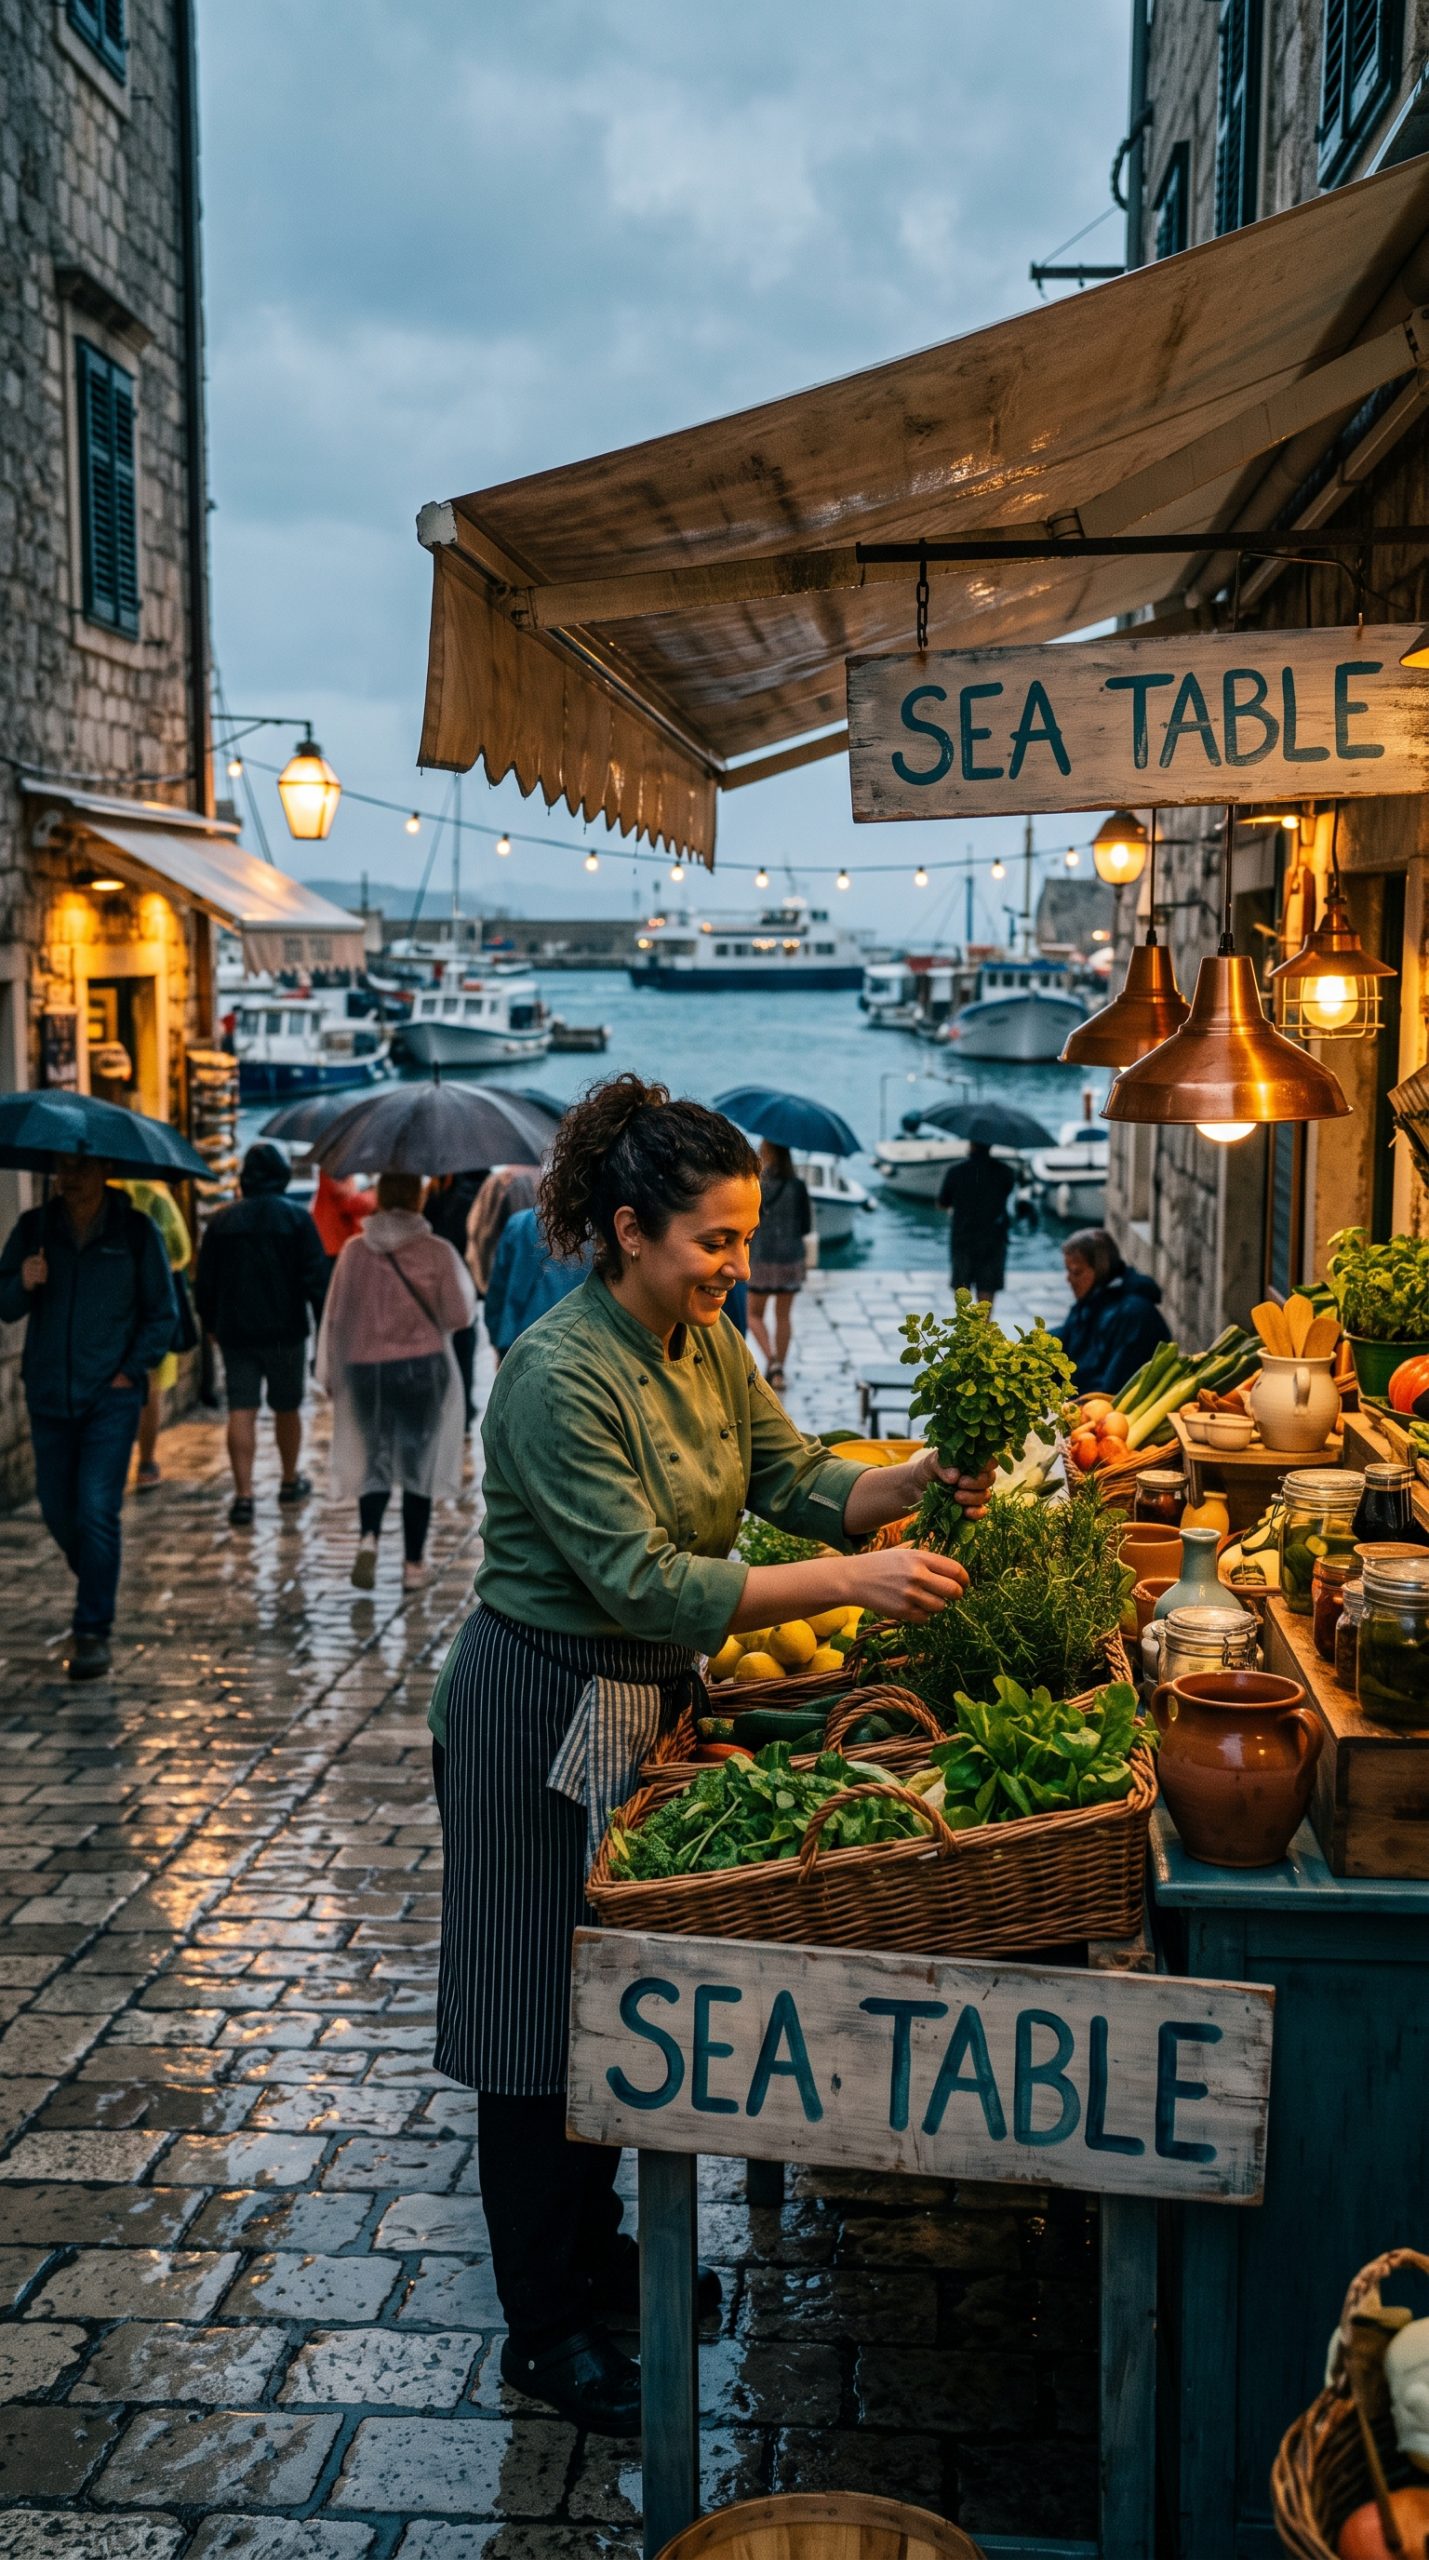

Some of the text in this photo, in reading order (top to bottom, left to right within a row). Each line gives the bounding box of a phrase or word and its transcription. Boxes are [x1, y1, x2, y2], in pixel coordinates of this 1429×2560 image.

[891, 661, 1385, 786] SEA TABLE
[606, 1977, 1223, 2163] SEA TABLE
